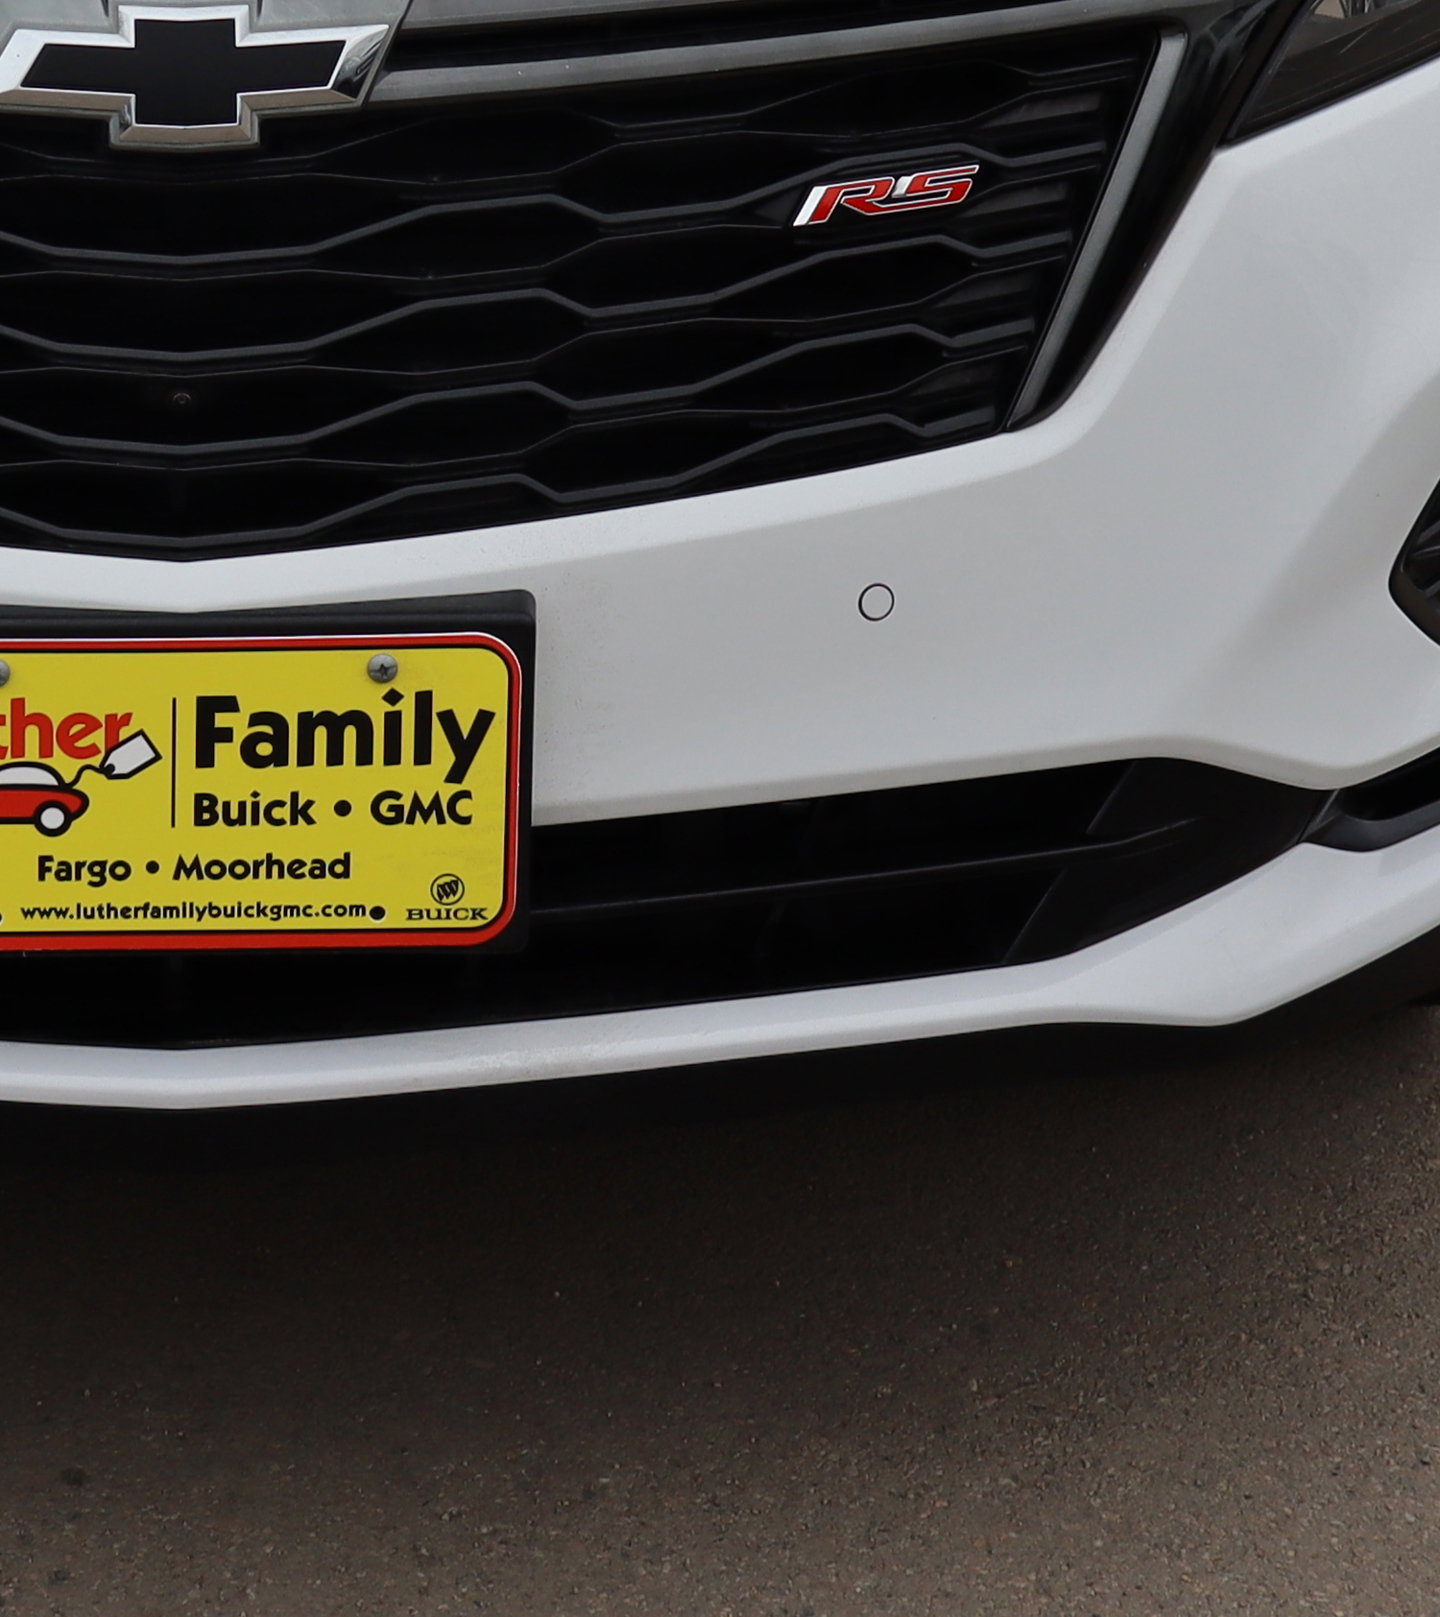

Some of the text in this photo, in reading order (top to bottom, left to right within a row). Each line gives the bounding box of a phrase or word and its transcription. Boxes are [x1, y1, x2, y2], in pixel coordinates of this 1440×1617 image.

[793, 165, 979, 226] RS
[195, 688, 496, 784] Family
[193, 789, 473, 828] Buick GMC
[38, 851, 351, 887] Fargo Moorhead
[20, 901, 367, 922] www.lutherfamilybuickgmc.com
[406, 907, 488, 921] BUICK
